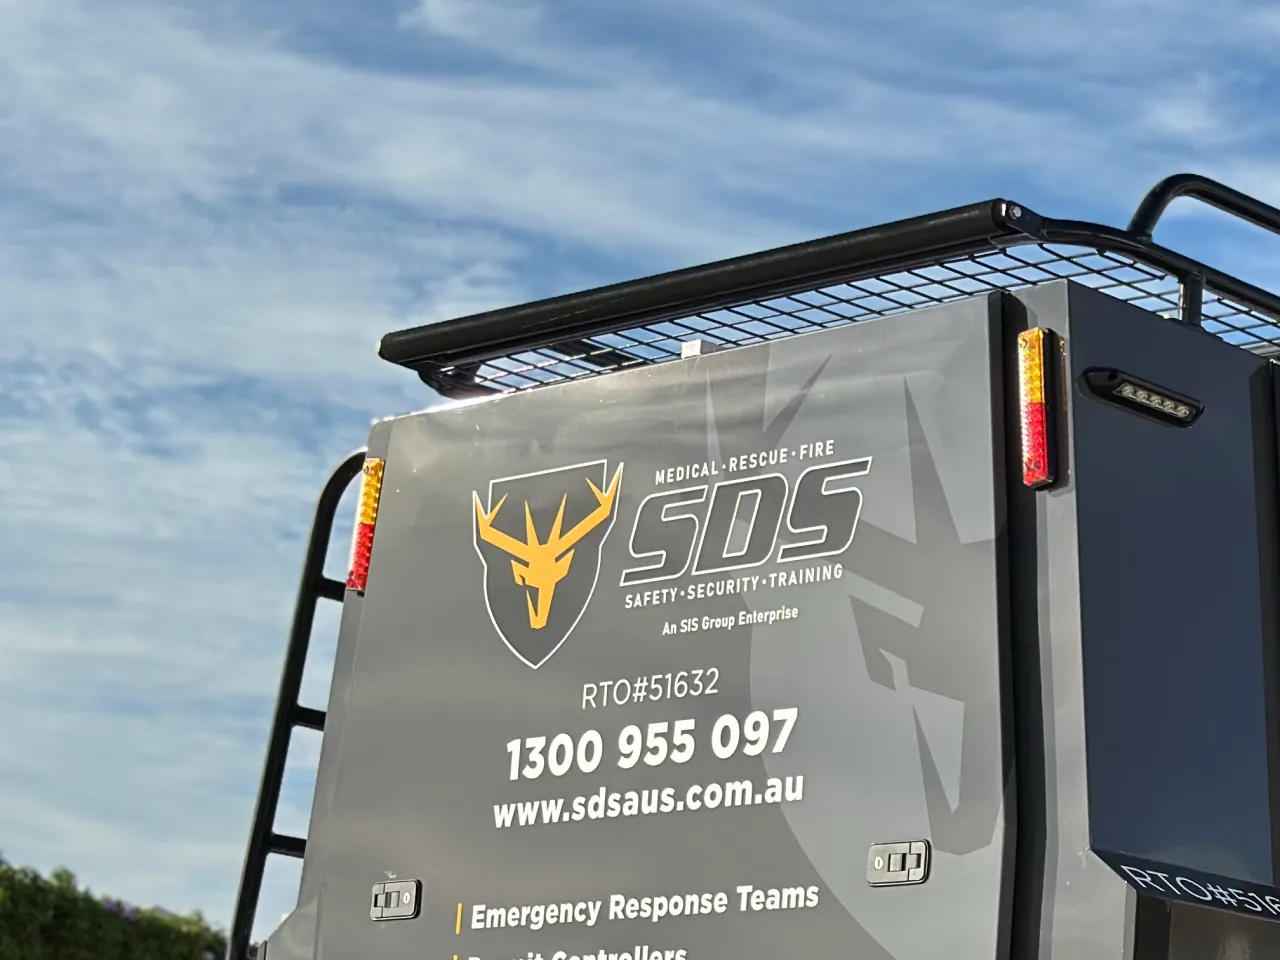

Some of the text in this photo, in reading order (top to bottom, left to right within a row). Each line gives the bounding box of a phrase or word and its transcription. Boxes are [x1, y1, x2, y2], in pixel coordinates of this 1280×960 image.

[800, 440, 835, 460] FIRE
[619, 456, 873, 586] SDS
[662, 605, 799, 636] An SIS Group Enterprise
[581, 667, 720, 709] RTO#51632
[506, 707, 798, 781] 1300 955 097
[493, 775, 804, 828] www.sdsaus.com.au
[470, 883, 820, 931] Emergency Response Teams
